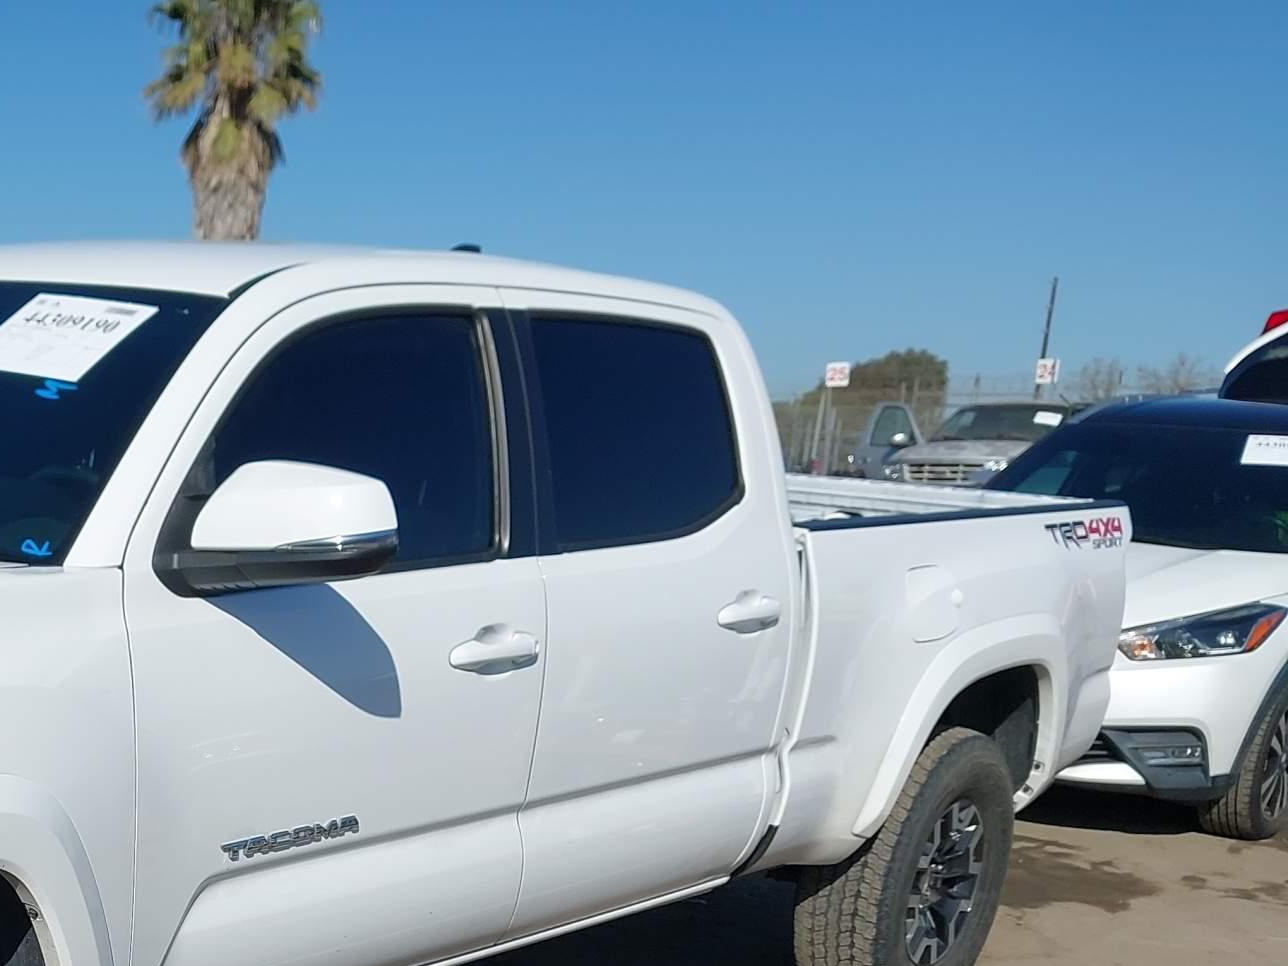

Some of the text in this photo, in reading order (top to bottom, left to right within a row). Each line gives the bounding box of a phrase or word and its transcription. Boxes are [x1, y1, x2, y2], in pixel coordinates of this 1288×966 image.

[1044, 520, 1089, 551] TRD
[1092, 537, 1123, 550] SPORT
[219, 814, 361, 862] TACOMA
